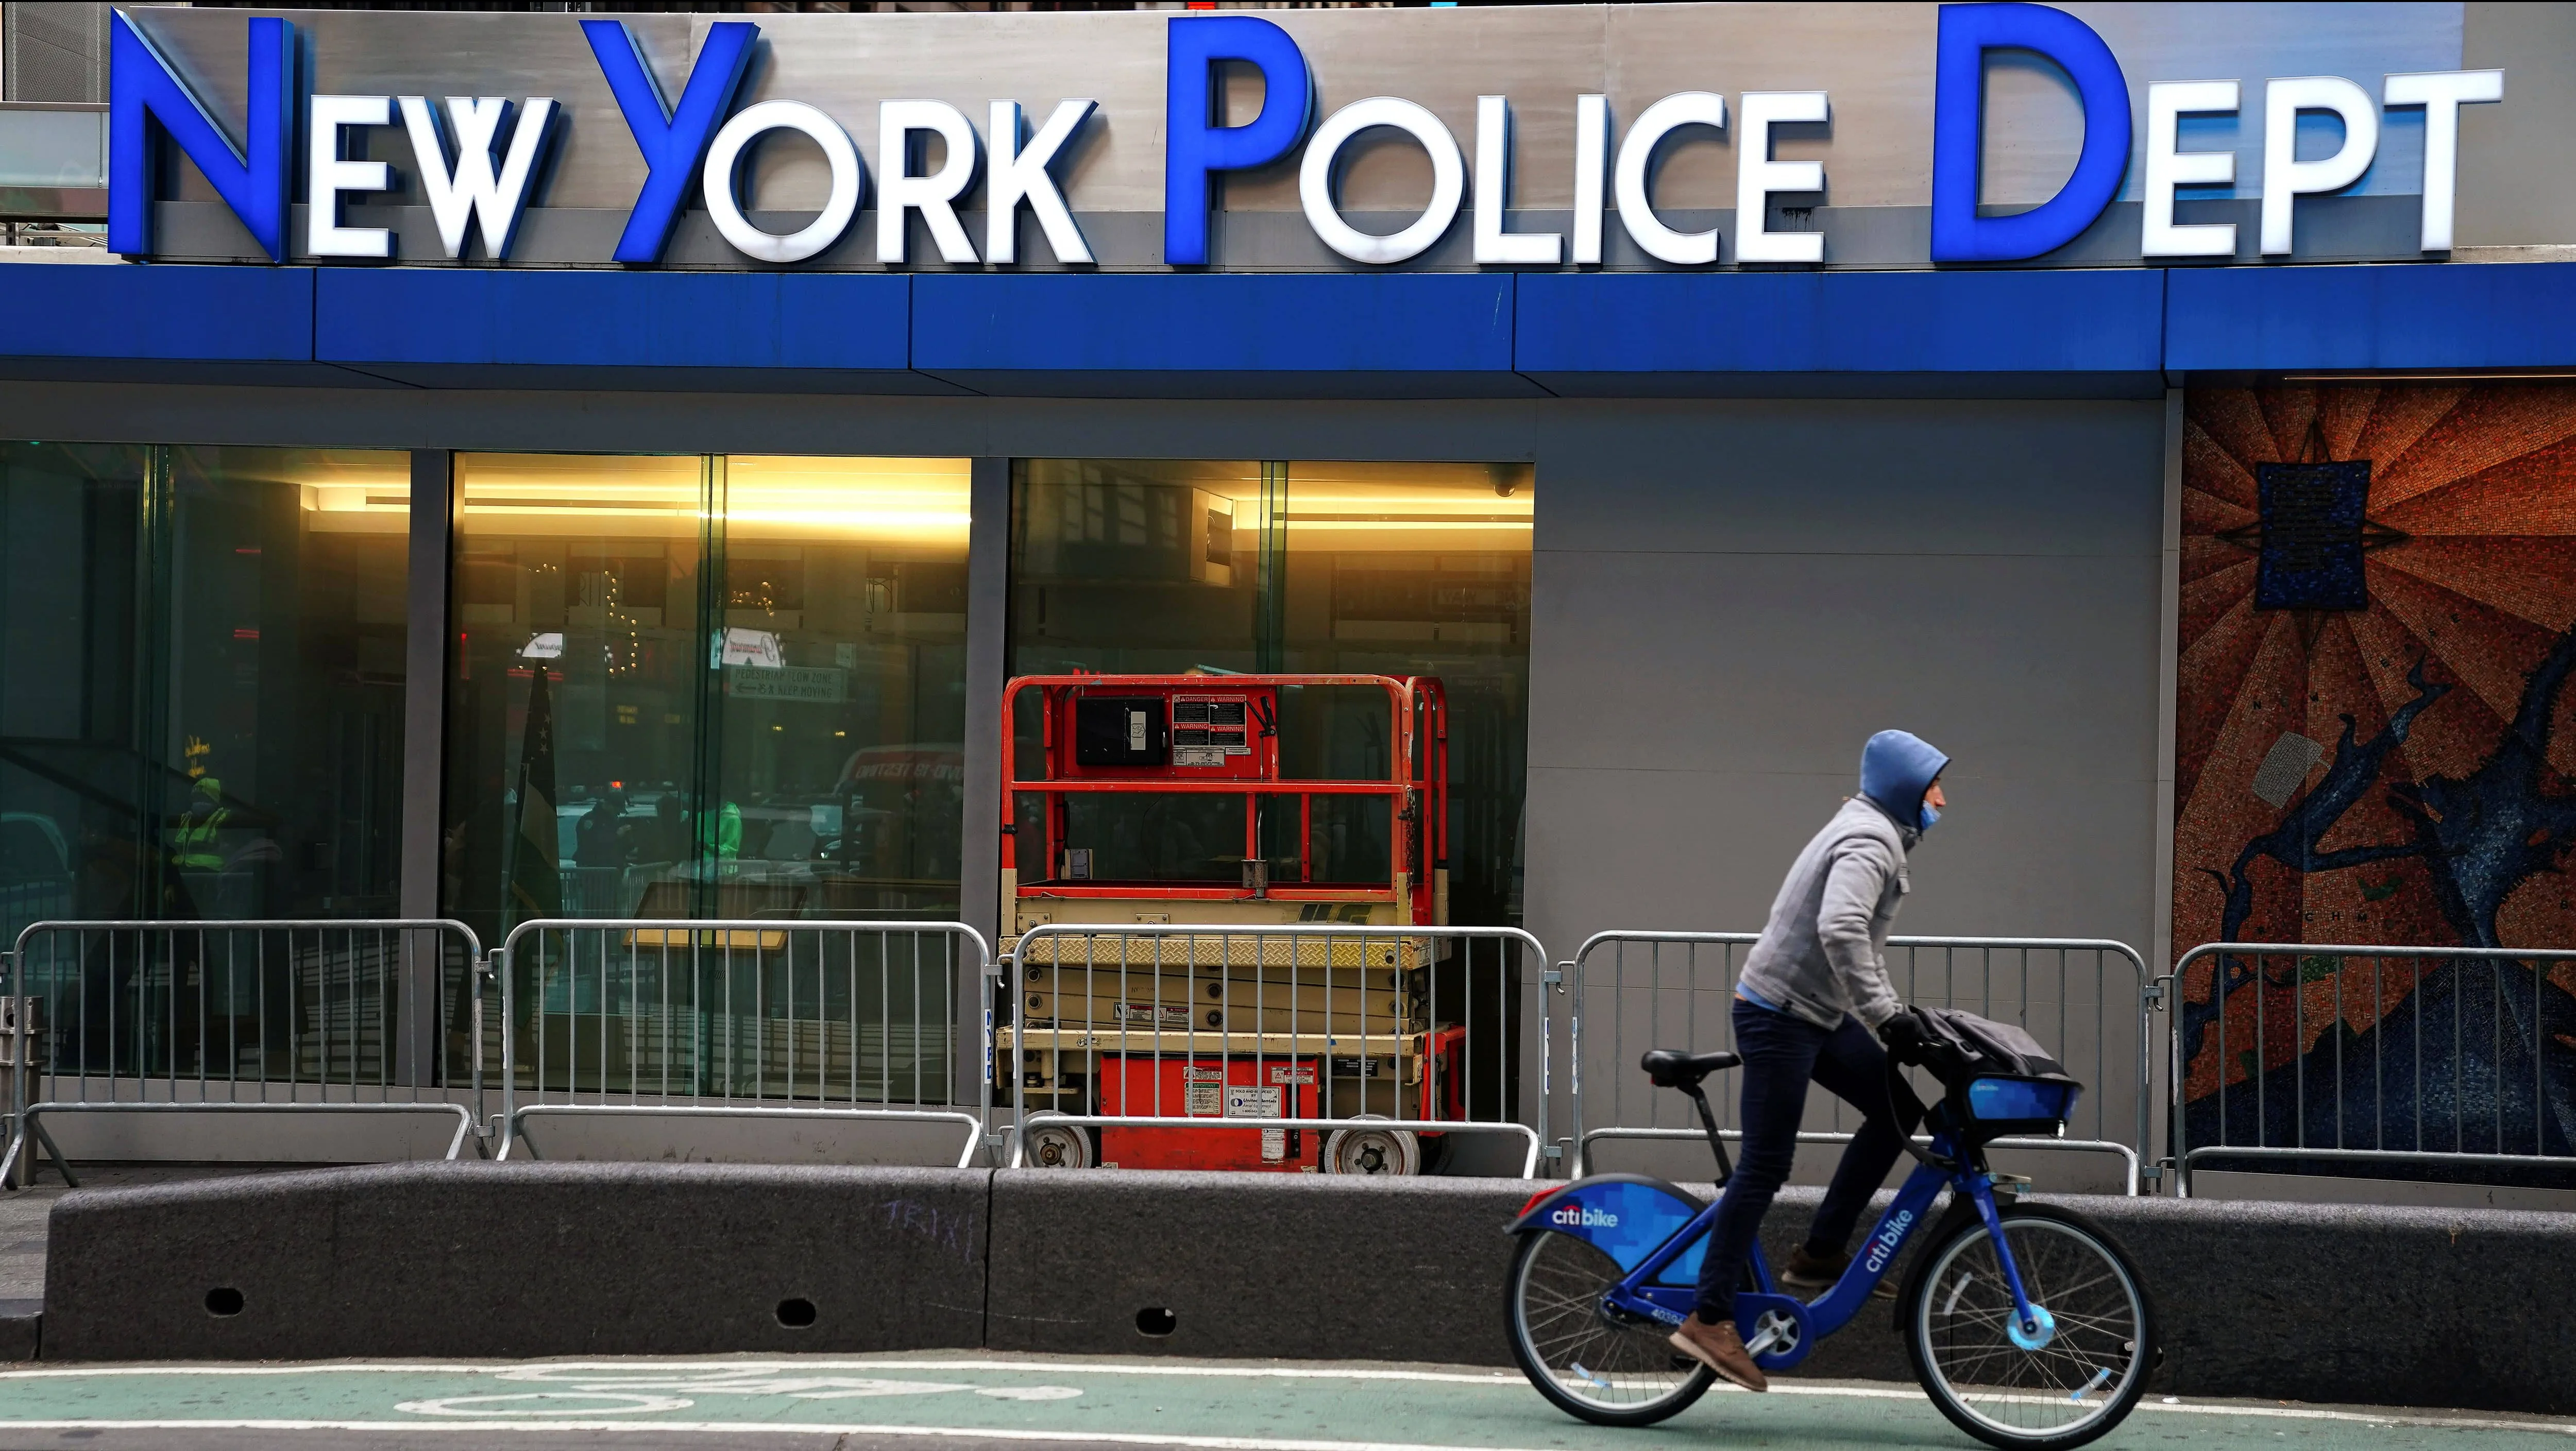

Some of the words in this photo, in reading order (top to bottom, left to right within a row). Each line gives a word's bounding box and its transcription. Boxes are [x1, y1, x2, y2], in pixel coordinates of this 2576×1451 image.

[107, 8, 560, 264] NEW
[578, 20, 1099, 265] YORK
[1163, 15, 1830, 265] POLICE
[1930, 2, 2505, 262] DEPT
[812, 673, 833, 684] ZONE
[778, 686, 798, 695] KEEP
[801, 687, 833, 698] MOVING
[1552, 1205, 1580, 1225] citi
[1581, 1208, 1619, 1227] bike
[1878, 1209, 1913, 1247] bike
[1866, 1242, 1891, 1272] citi
